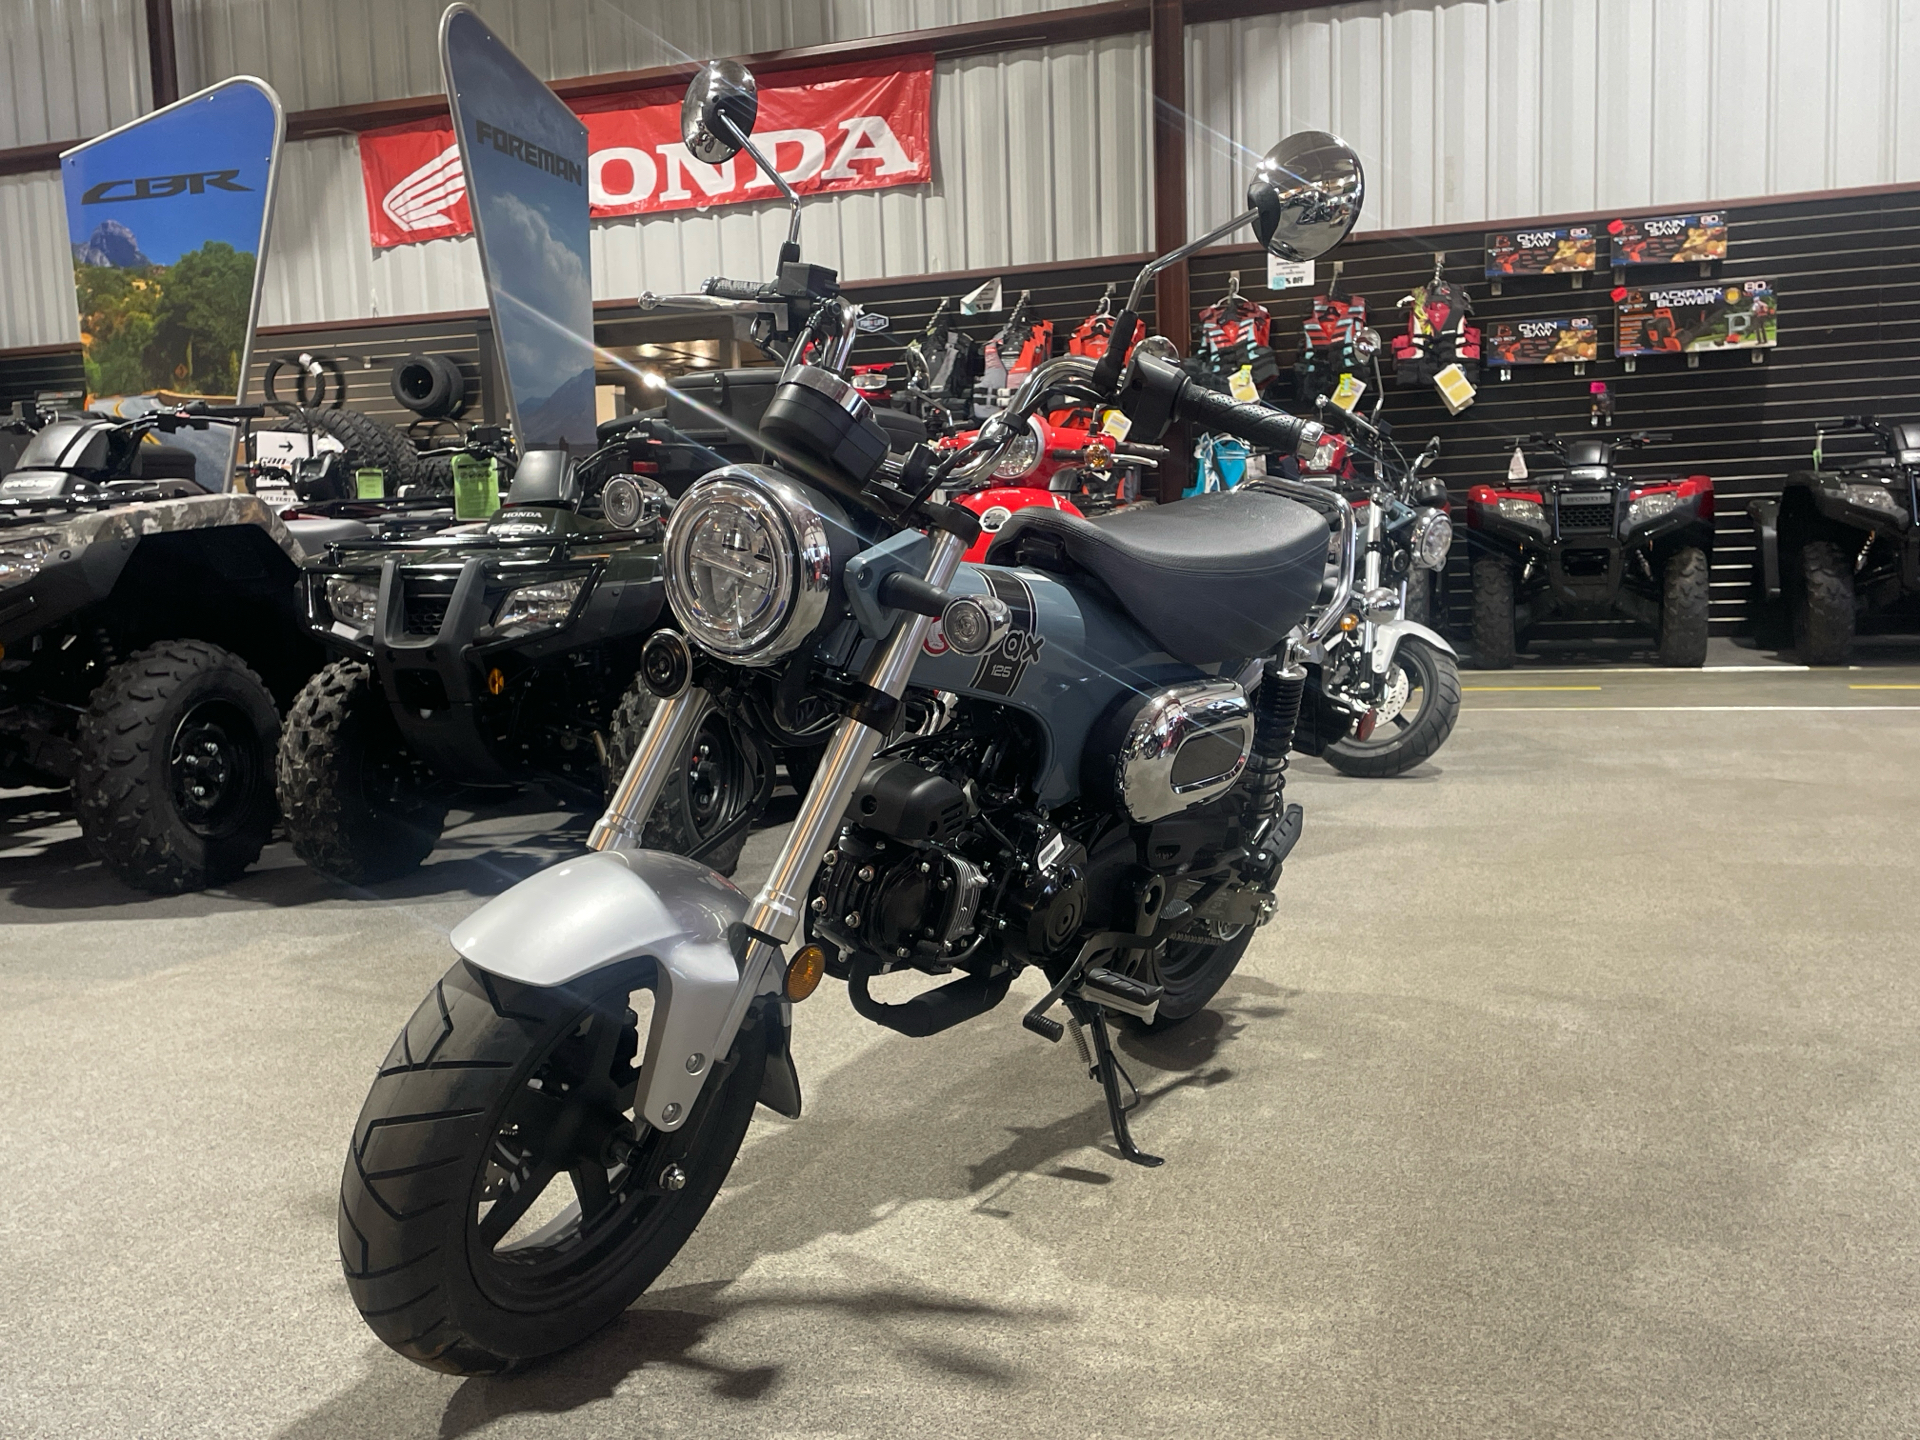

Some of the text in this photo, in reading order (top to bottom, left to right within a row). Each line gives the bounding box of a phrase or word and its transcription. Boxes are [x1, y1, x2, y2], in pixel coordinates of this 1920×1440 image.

[475, 119, 582, 187] FOREMAN
[588, 115, 919, 206] ONDA
[81, 169, 256, 205] CBR
[1644, 219, 1686, 231] CHAIN
[1700, 214, 1719, 225] 80
[1516, 231, 1556, 243] CHAIN
[1569, 227, 1588, 237] 80
[1649, 227, 1681, 237] SAW
[1521, 239, 1551, 249] SAW
[1743, 280, 1766, 292] 80
[1650, 287, 1722, 301] BACKPACK
[1656, 296, 1715, 308] BLOWER
[1518, 321, 1558, 332] CHAIN
[1571, 317, 1589, 327] 80
[1523, 329, 1553, 338] SAW
[502, 511, 542, 519] HONDA
[487, 523, 548, 535] RECON
[1002, 629, 1046, 665] ax
[990, 664, 1012, 678] 125
